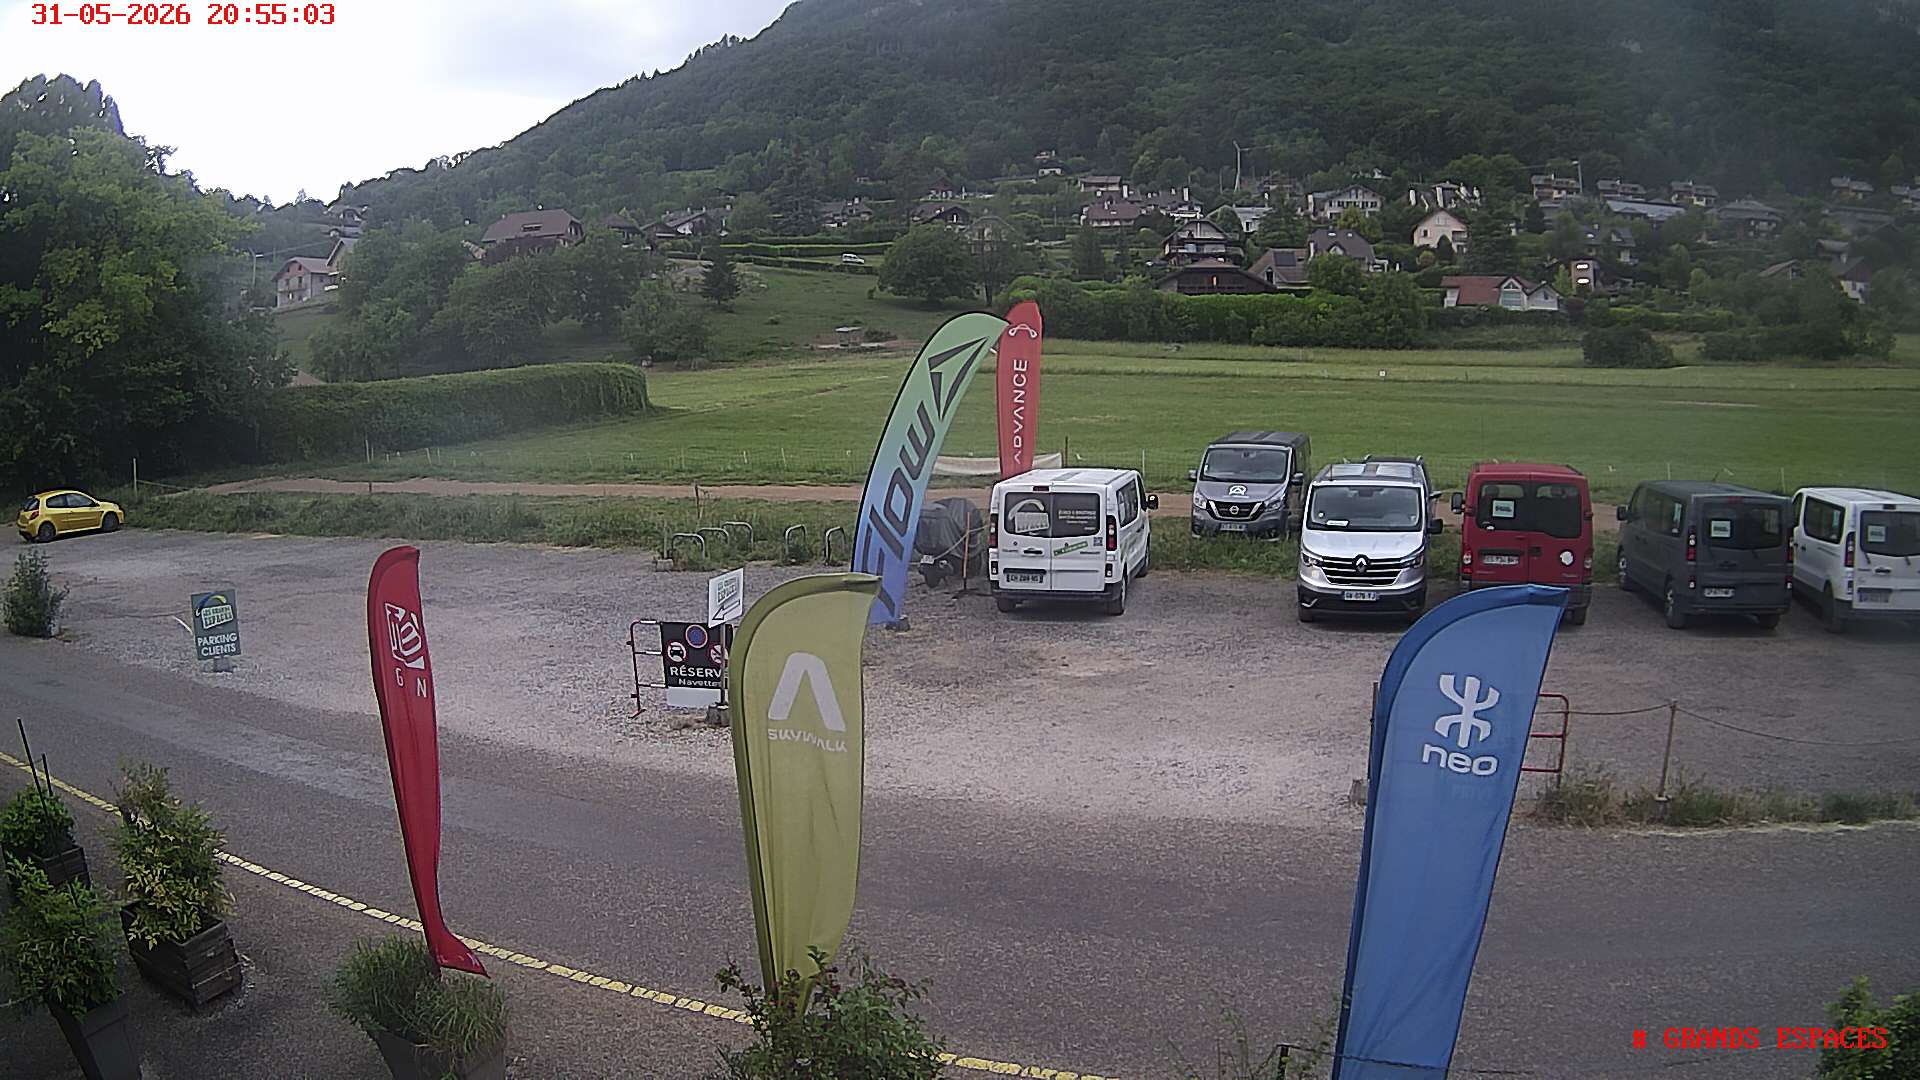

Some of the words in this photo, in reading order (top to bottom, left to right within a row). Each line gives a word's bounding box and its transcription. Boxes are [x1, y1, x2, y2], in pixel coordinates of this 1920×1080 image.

[1013, 359, 1028, 465] ADVANCE
[197, 633, 238, 646] PARKING
[201, 643, 236, 656] CLIENTS
[395, 667, 427, 698] GN
[1422, 743, 1499, 776] neo
